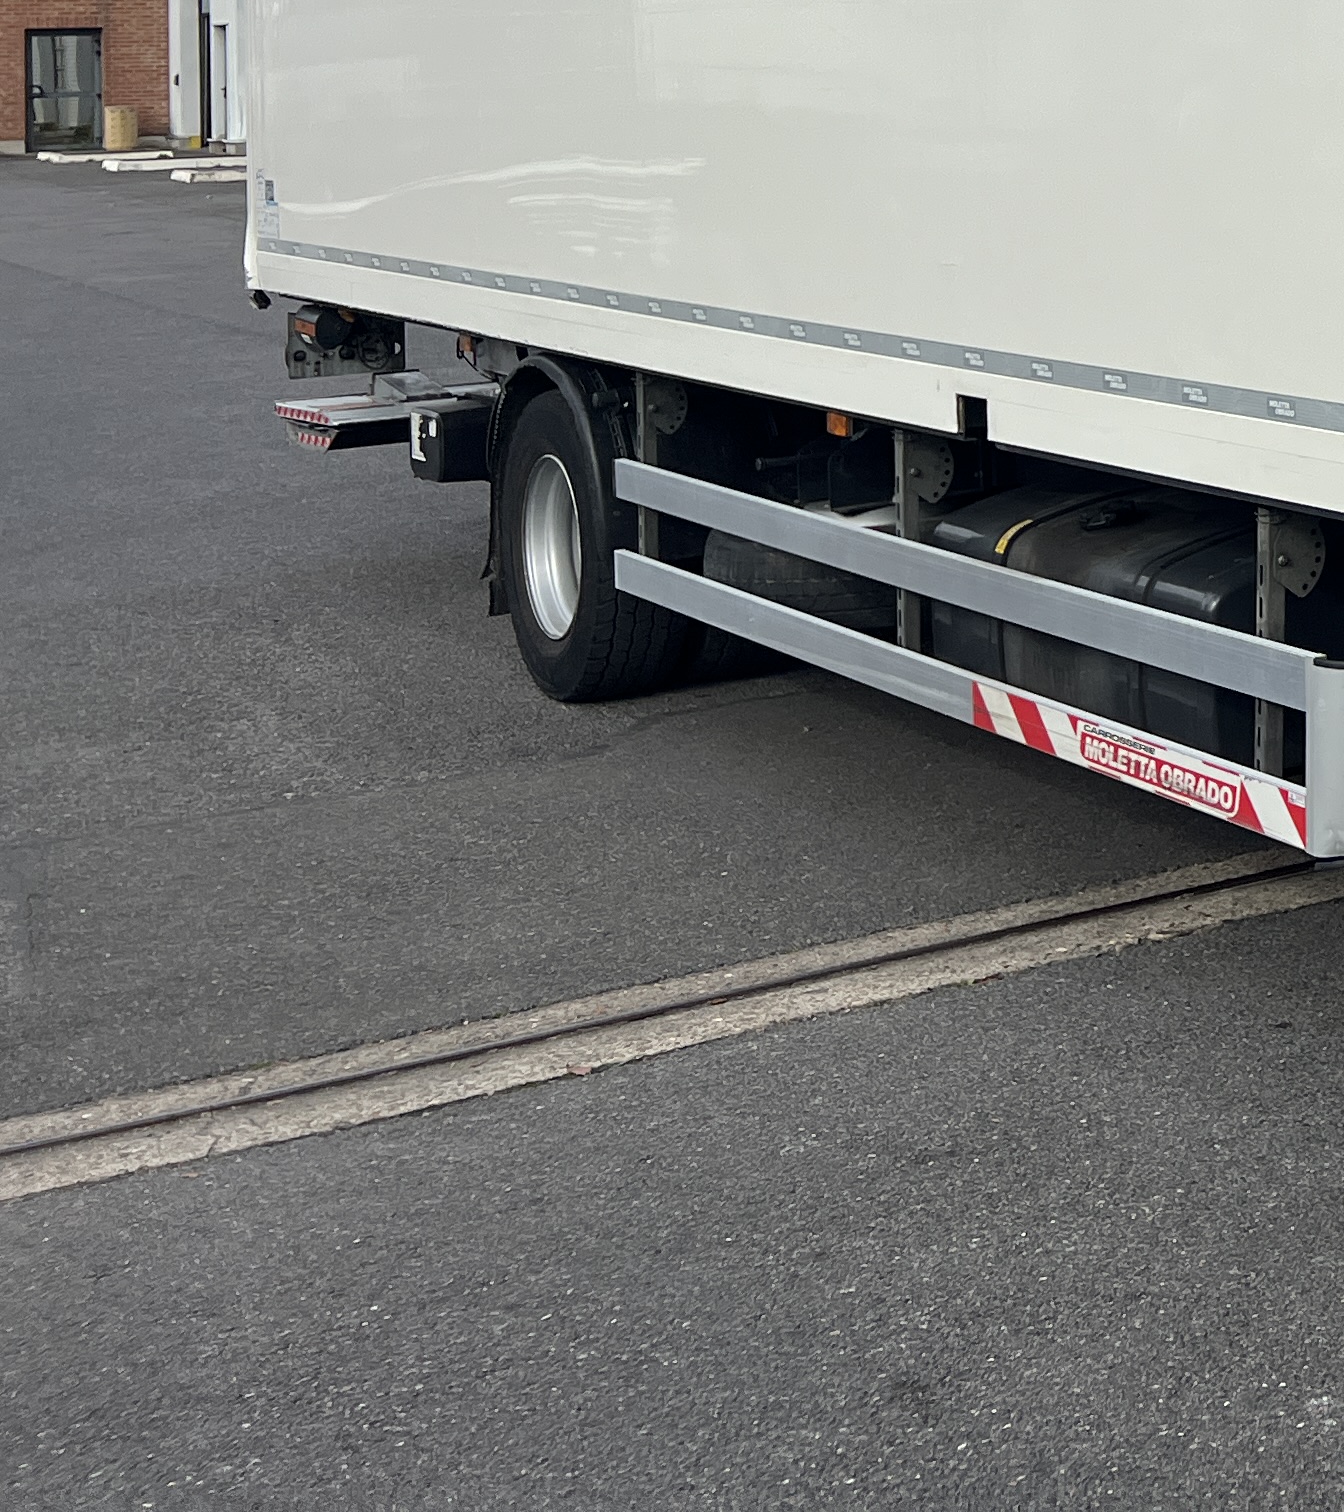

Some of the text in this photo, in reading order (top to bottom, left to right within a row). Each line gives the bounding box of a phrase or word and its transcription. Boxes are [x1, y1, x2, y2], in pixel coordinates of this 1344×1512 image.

[1083, 724, 1156, 755] CARROSSERIE
[1084, 736, 1233, 810] MOLETTA OBRADO
